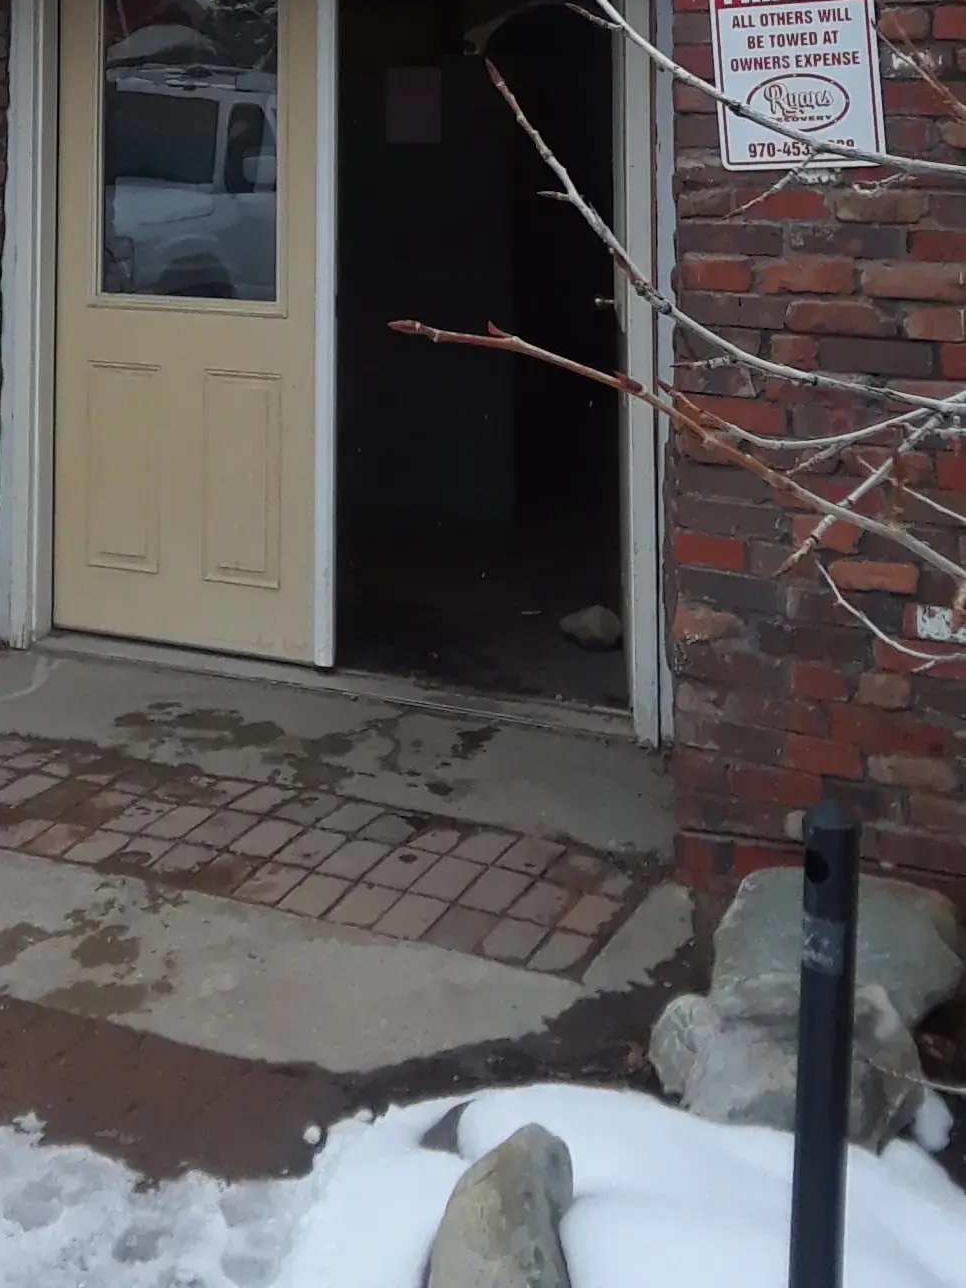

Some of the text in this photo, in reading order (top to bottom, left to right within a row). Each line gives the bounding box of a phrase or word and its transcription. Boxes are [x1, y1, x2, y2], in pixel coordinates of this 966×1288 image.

[731, 7, 853, 30] ALL OTHERS WILL
[747, 30, 839, 50] BE TOWED AT
[730, 50, 861, 73] OWNERS EXPENSE
